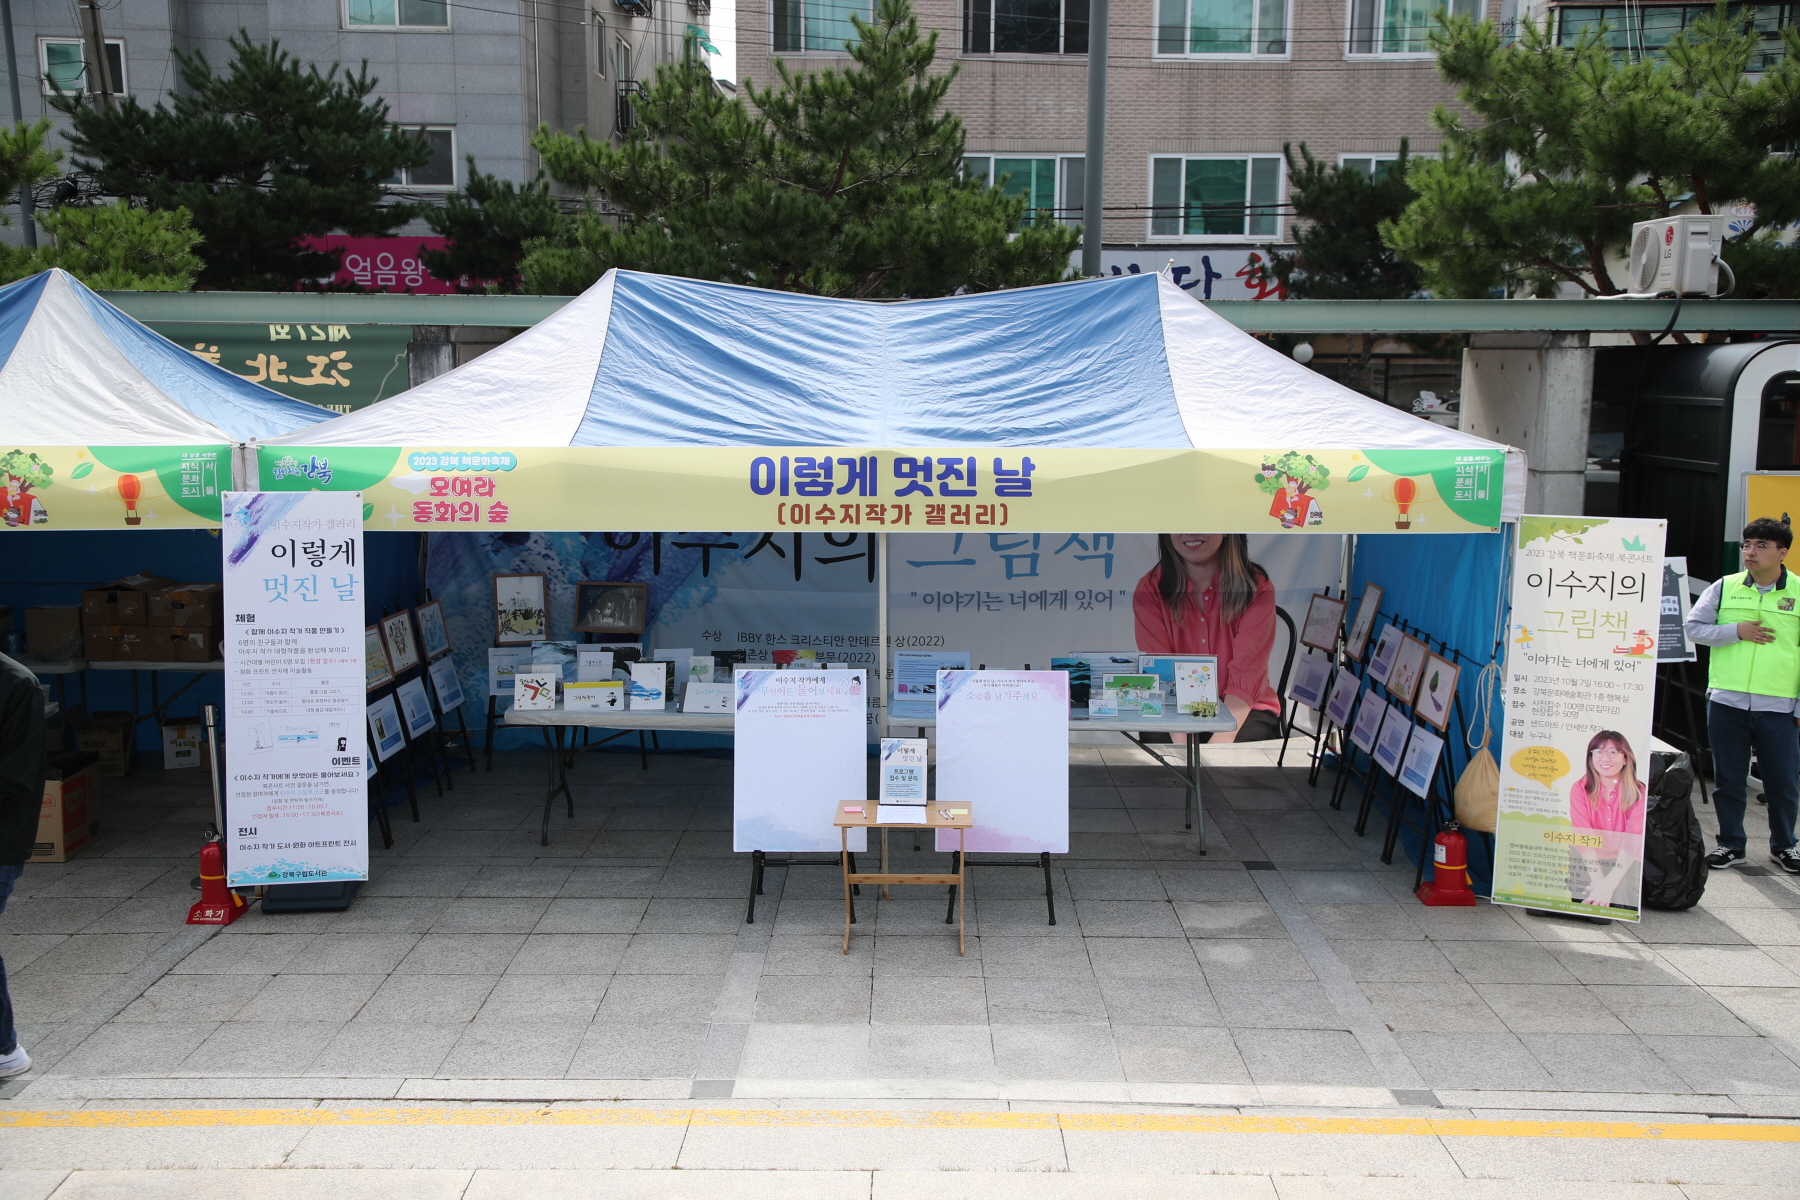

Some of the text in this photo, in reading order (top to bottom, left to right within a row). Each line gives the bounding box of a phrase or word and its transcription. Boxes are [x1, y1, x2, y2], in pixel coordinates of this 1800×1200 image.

[181, 462, 199, 470] 지식
[413, 456, 510, 466] 2023 강북 책문화축제
[301, 456, 333, 484] 강북
[1456, 466, 1474, 474] 지식
[182, 474, 200, 483] 문화
[750, 456, 1036, 497] 이렇게 멋진 날
[1456, 478, 1473, 487] 문화
[182, 487, 200, 496] 도시
[428, 476, 496, 498] 모여라
[1454, 490, 1472, 498] 도시
[412, 500, 509, 523] 동화의 숲
[777, 502, 1008, 526] (이수지작가 갤러리)
[271, 519, 356, 531] 이수지작가 갤러리
[271, 538, 356, 568] 이렇게
[1526, 549, 1655, 564] 2023 강북 책문화축제 북콘서트
[262, 573, 359, 602] 멋진 날
[1527, 567, 1645, 603] 이수지의
[1010, 590, 1068, 611] 너에게
[235, 614, 256, 623] 체험
[1537, 608, 1628, 642] 그림책
[701, 629, 722, 642] 수상
[737, 632, 762, 644] IBBY
[765, 632, 787, 645] 한스
[790, 634, 845, 647] 크리스티안
[894, 635, 945, 648] 상(2022)
[1523, 652, 1572, 667] "이야기는
[1576, 657, 1609, 670] 너에게
[798, 676, 826, 684] 작가에게
[1513, 674, 1644, 691] 일시 2023년 10월 7일 16:00 17:30
[760, 686, 794, 696] 무엇이든
[966, 690, 1039, 701] 소감을 남겨주세요
[1512, 687, 1629, 703] 장소 강북문화예술회관 1층 행복실
[1512, 700, 1620, 714] 접수 사전접수 100명 (모집마감)
[1532, 707, 1579, 719] 현장접수 50명
[1530, 720, 1559, 729] 샌드아트
[1589, 724, 1604, 733] 작가
[1510, 731, 1552, 740] 대상 누구나
[332, 756, 361, 766] 이벤트
[238, 827, 257, 836] 전시
[1543, 830, 1602, 848] 이수지 작가
[282, 870, 328, 878] 강북구립도서관
[193, 909, 224, 918] 소화기
